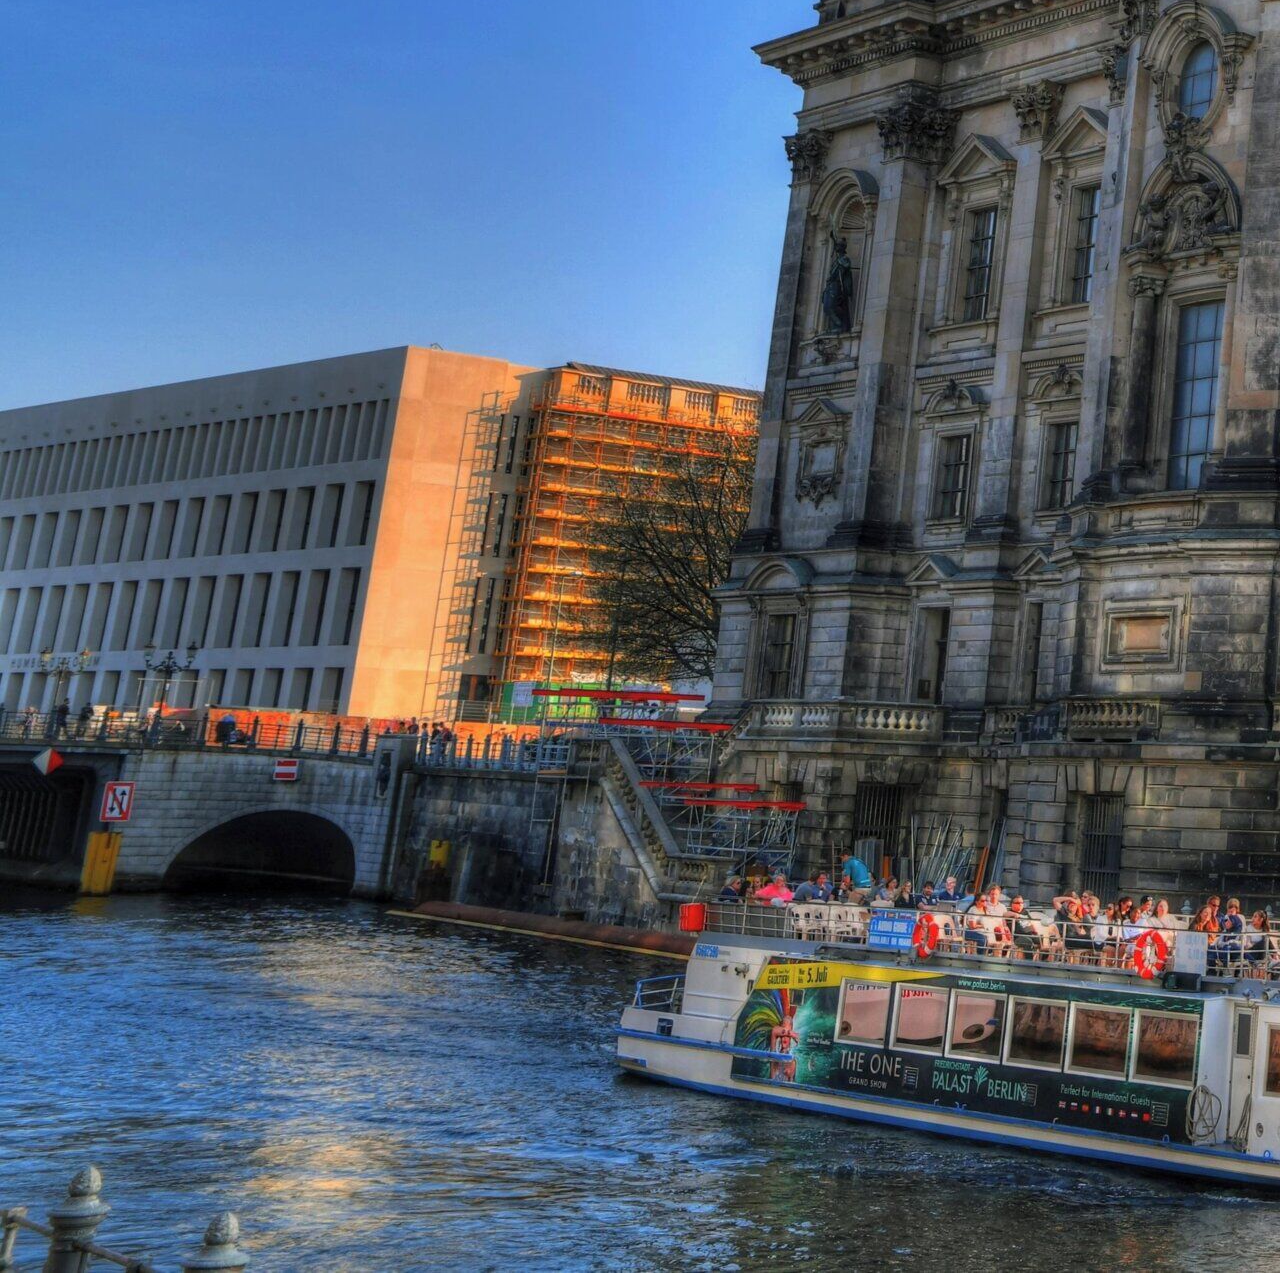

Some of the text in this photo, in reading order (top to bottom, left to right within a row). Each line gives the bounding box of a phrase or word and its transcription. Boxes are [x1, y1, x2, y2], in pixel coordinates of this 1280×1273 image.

[807, 966, 828, 983] 5. Juli
[958, 979, 1006, 991] www.palast.berlin
[840, 1049, 903, 1078] THE ONE
[848, 1076, 888, 1090] GRAND SHOW
[931, 1070, 1026, 1102] PALAST BERLIN
[1060, 1083, 1151, 1107] Perfect for International Guests
